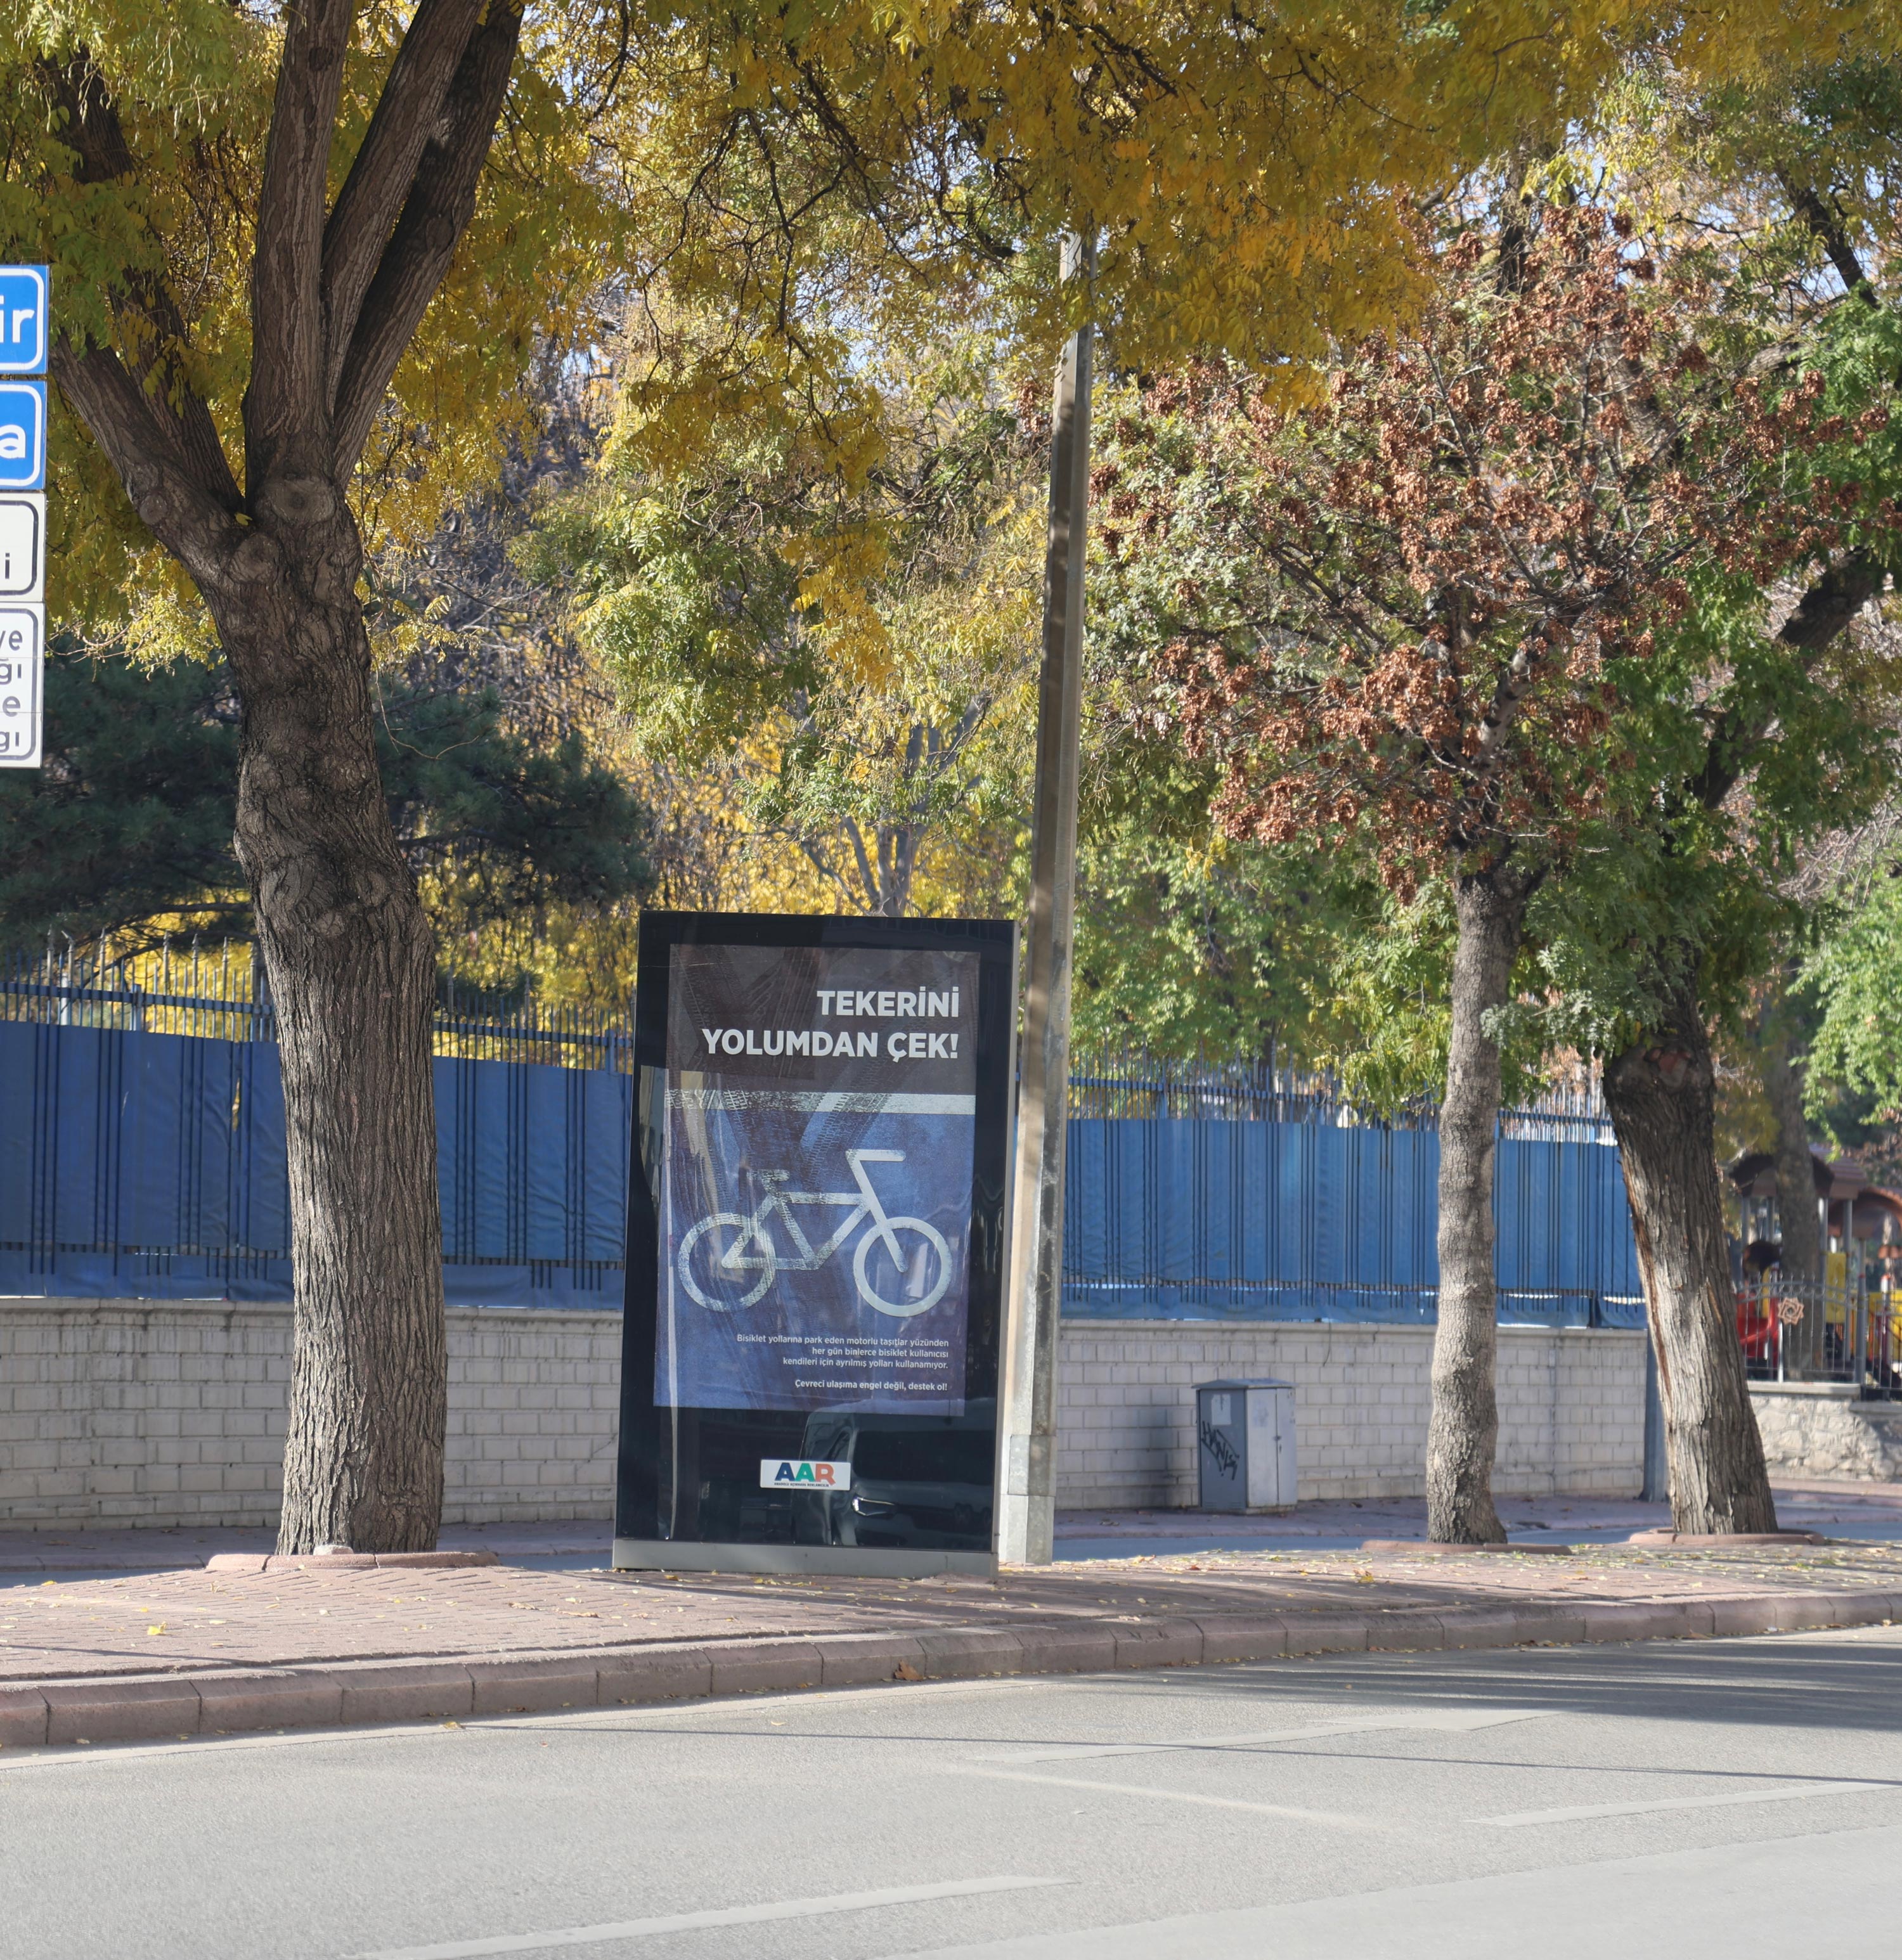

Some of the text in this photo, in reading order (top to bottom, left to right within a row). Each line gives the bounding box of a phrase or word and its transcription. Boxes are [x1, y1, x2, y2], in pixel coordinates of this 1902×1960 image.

[817, 986, 959, 1017] TEKERİNİ
[702, 1029, 959, 1062] YOLUMDAN ÇEK!
[737, 1334, 766, 1343] Bisiklet
[768, 1335, 802, 1344] yollarına
[805, 1336, 822, 1344] park
[880, 1338, 908, 1346] taşıtlar
[910, 1339, 948, 1347] yüzünden
[910, 1350, 948, 1358] kullanıcısı
[783, 1357, 948, 1370] kendileri için ayrılmış yolları kullanamıyor.
[795, 1379, 948, 1391] Çevreci ulaşıma engel değil, destek ol!
[775, 1462, 836, 1485] AAR
